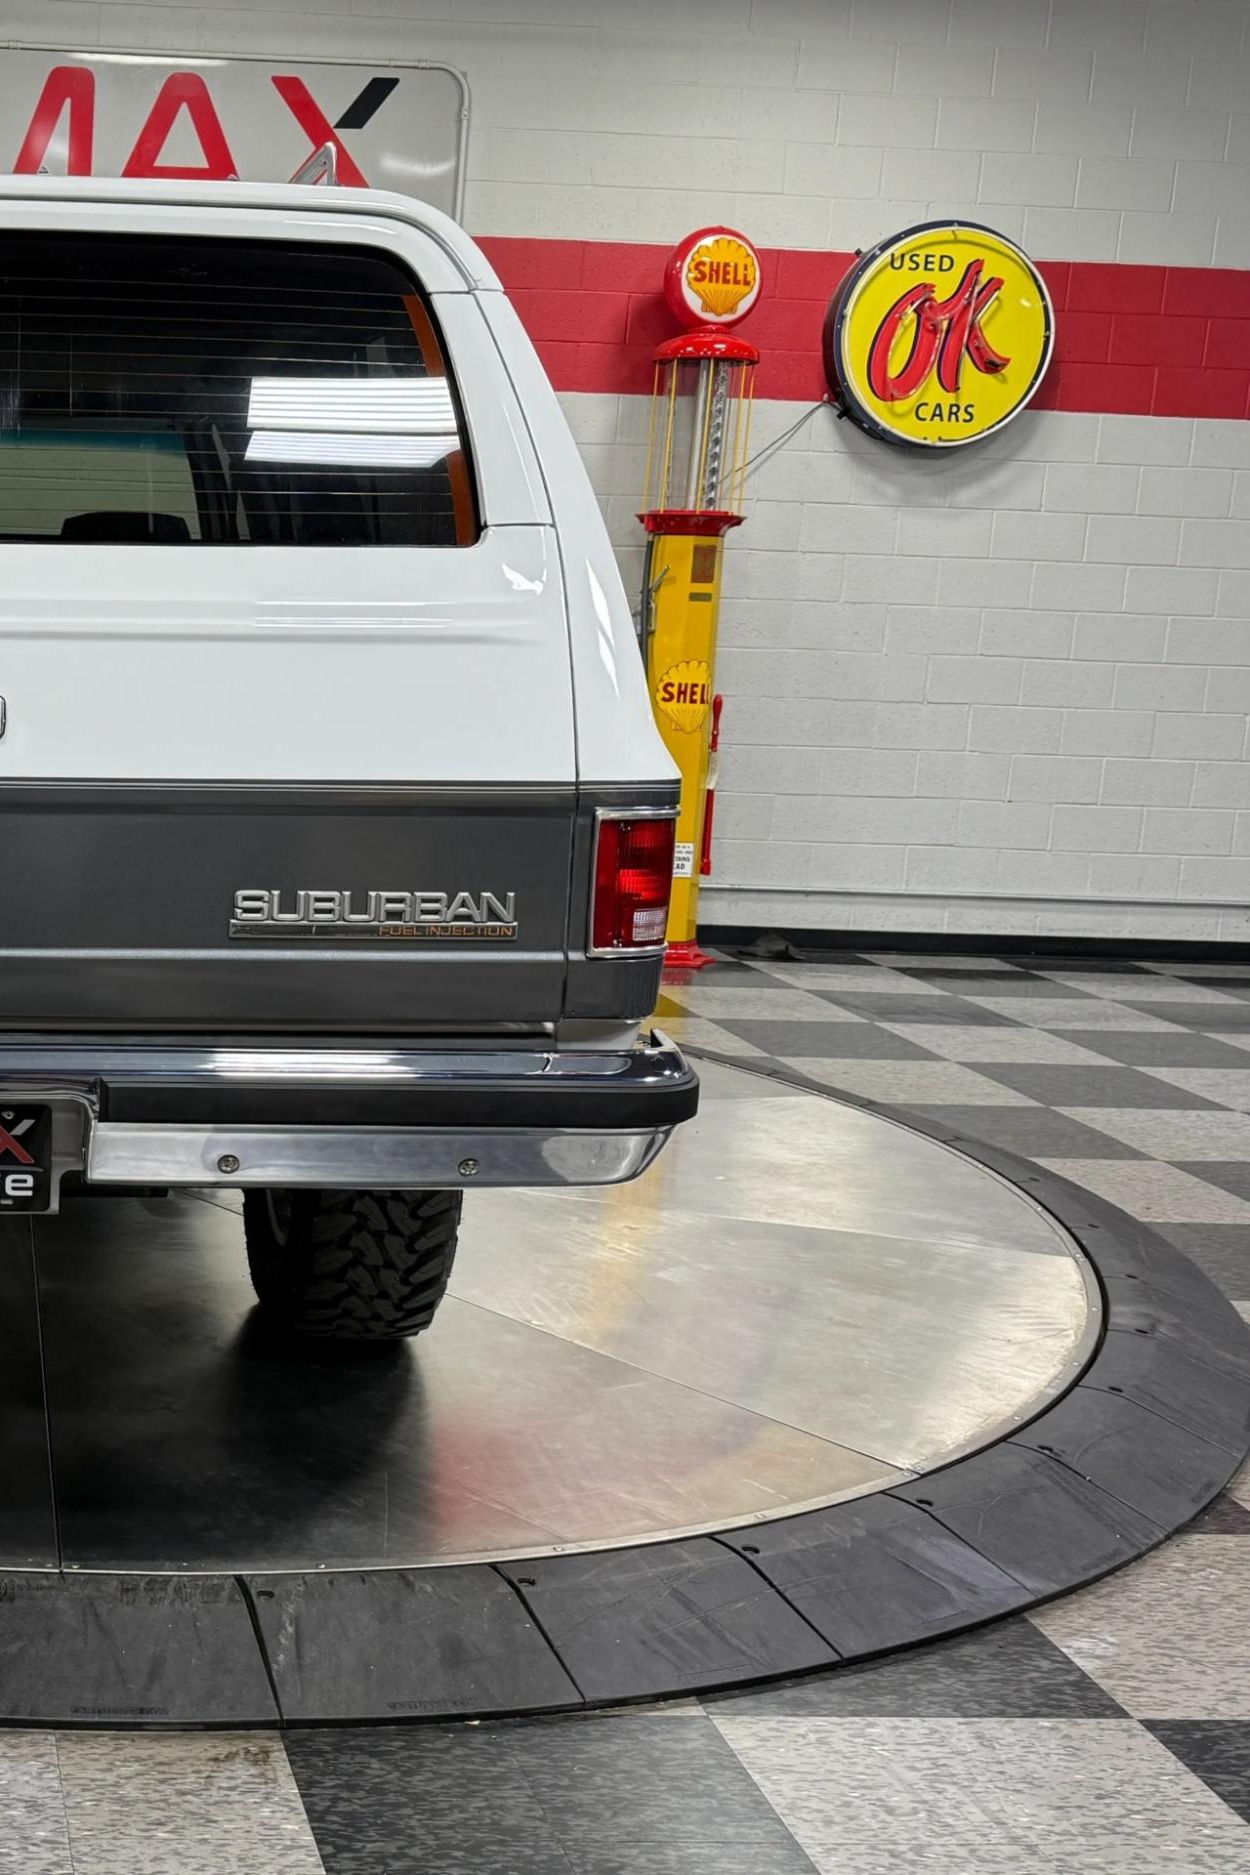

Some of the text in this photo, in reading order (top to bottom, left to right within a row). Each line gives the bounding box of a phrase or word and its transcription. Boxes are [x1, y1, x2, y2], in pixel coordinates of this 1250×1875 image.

[693, 260, 751, 287] SHELL
[890, 253, 954, 272] USED
[867, 259, 1011, 402] OK
[915, 402, 975, 423] CARS
[234, 889, 516, 922] SUBURBAN
[379, 926, 513, 936] FUEL INJECTION
